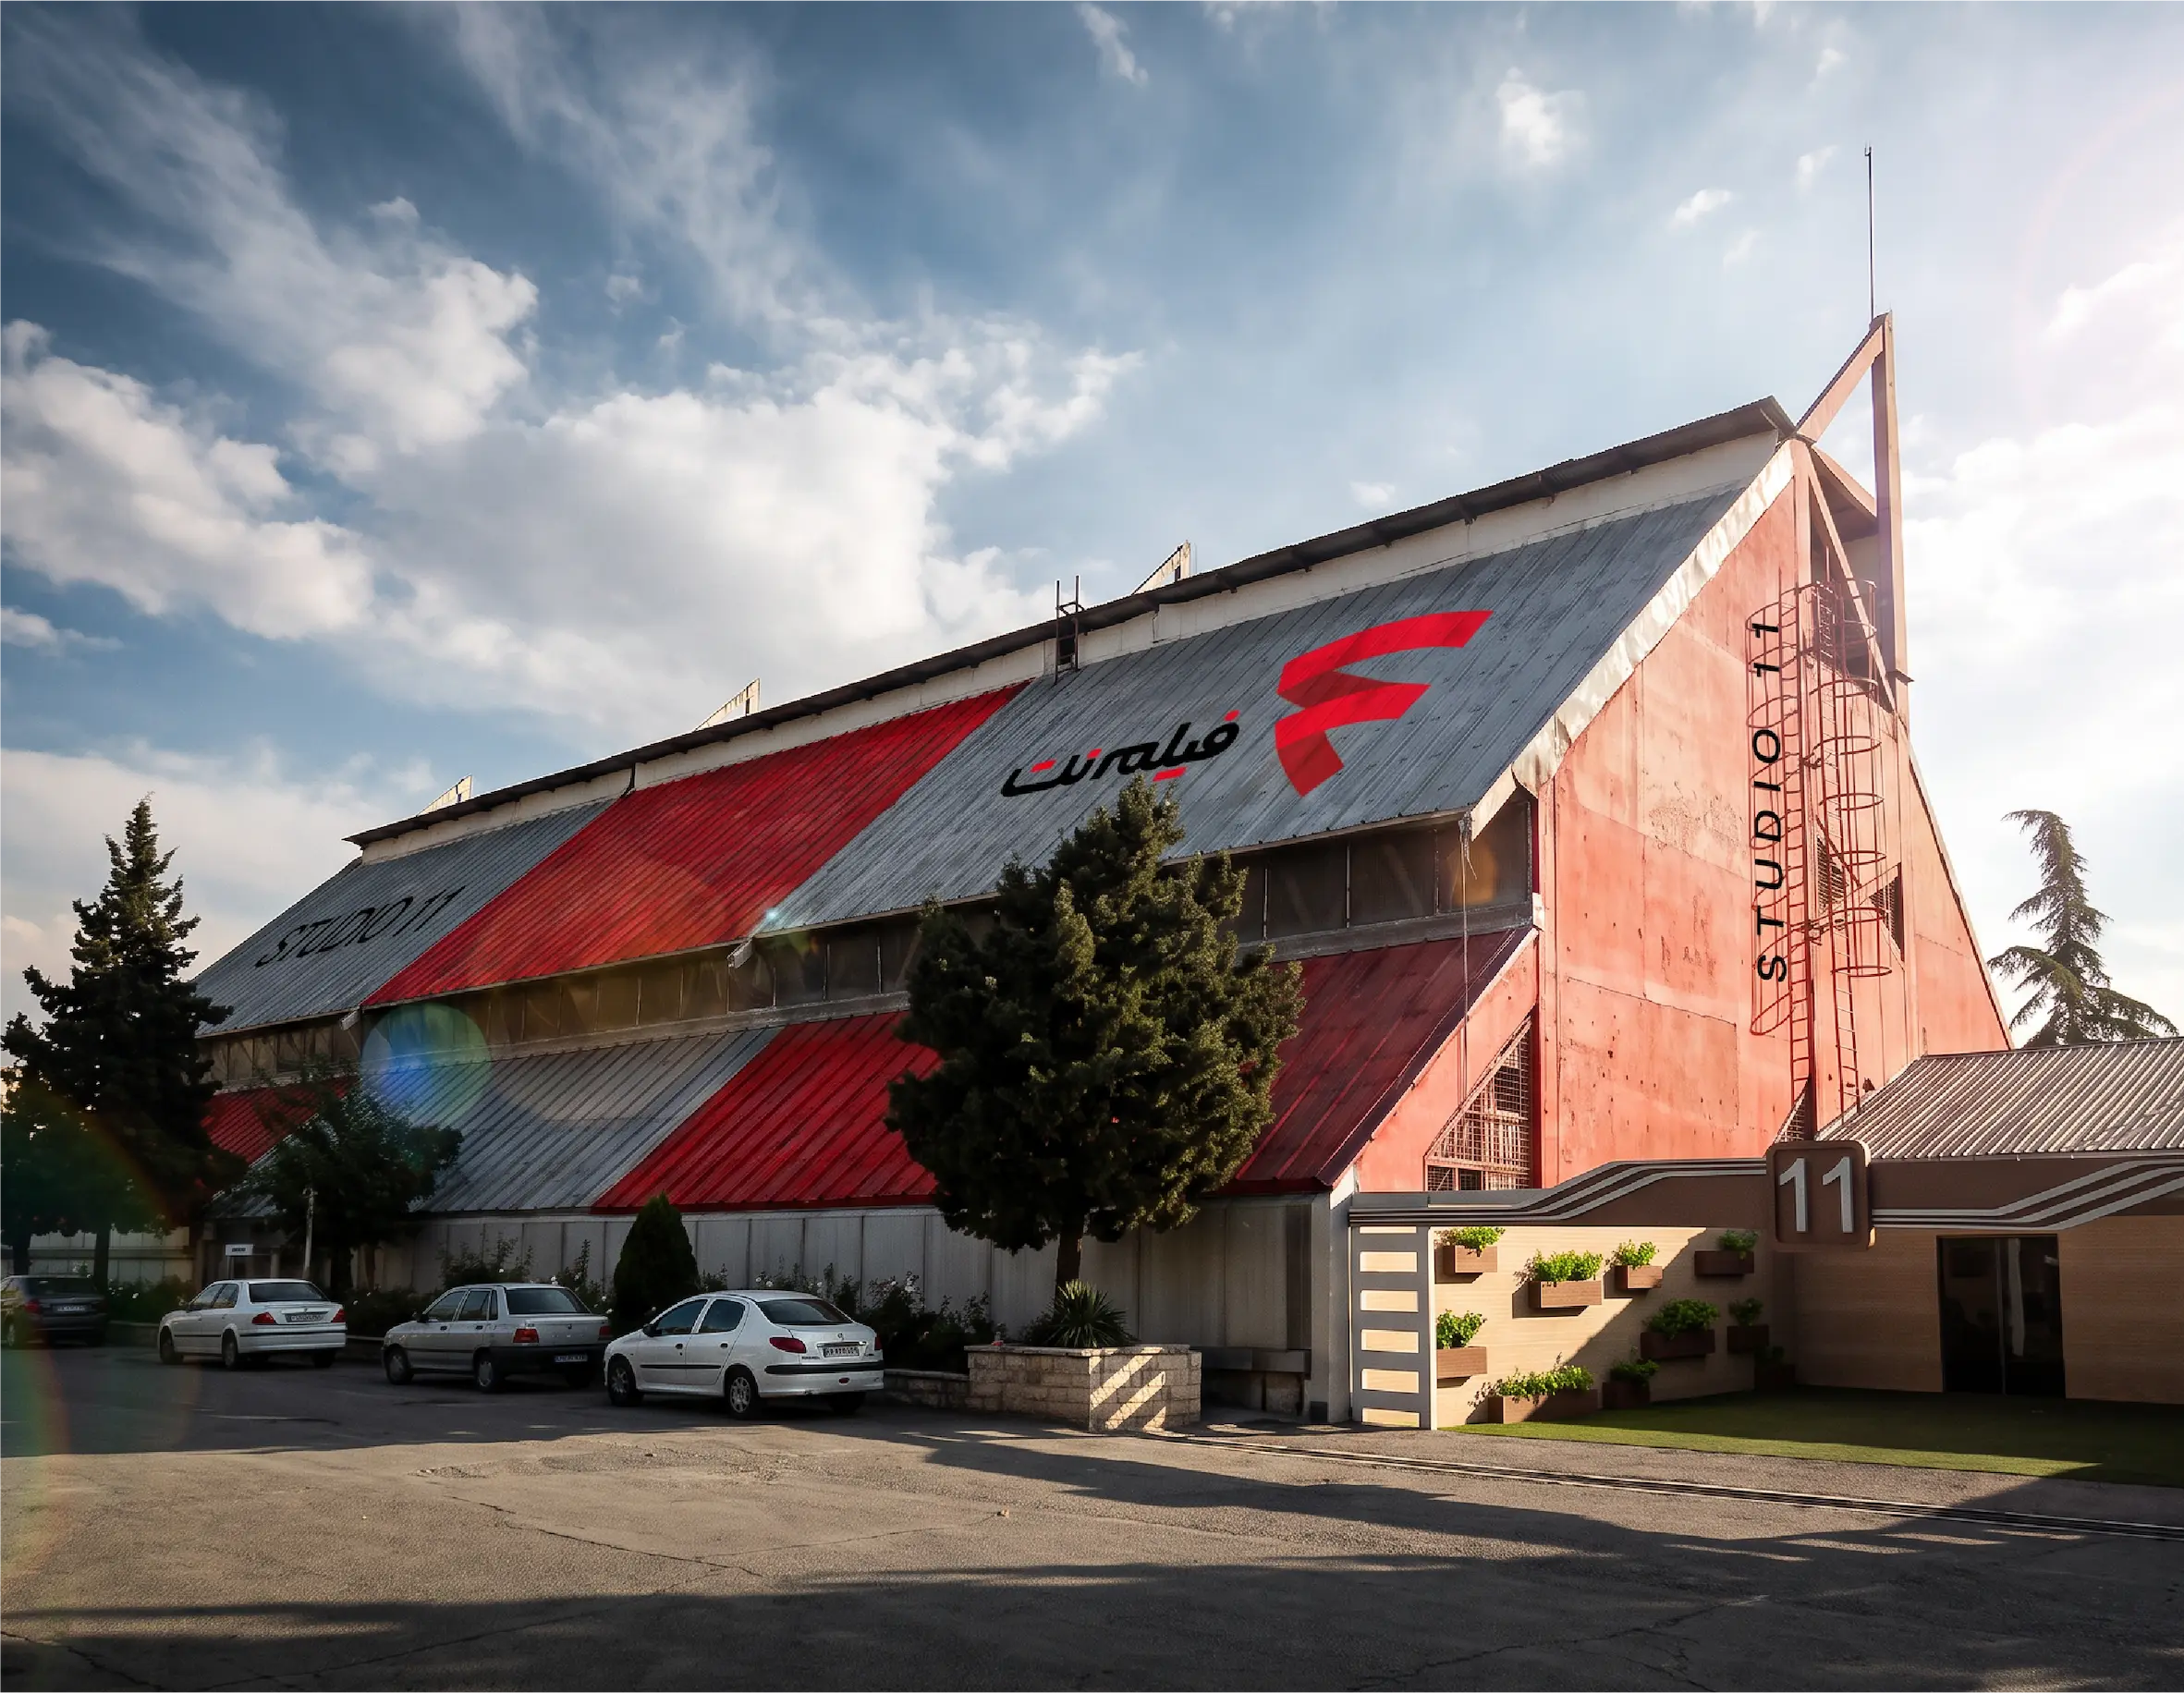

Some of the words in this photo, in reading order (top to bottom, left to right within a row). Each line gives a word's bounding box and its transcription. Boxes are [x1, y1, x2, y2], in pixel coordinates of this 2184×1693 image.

[1751, 623, 1780, 677] 11
[1752, 728, 1787, 982] STUDIO
[255, 896, 414, 968] STUDIO
[392, 885, 466, 937] 11
[1779, 1156, 1853, 1233] 11
